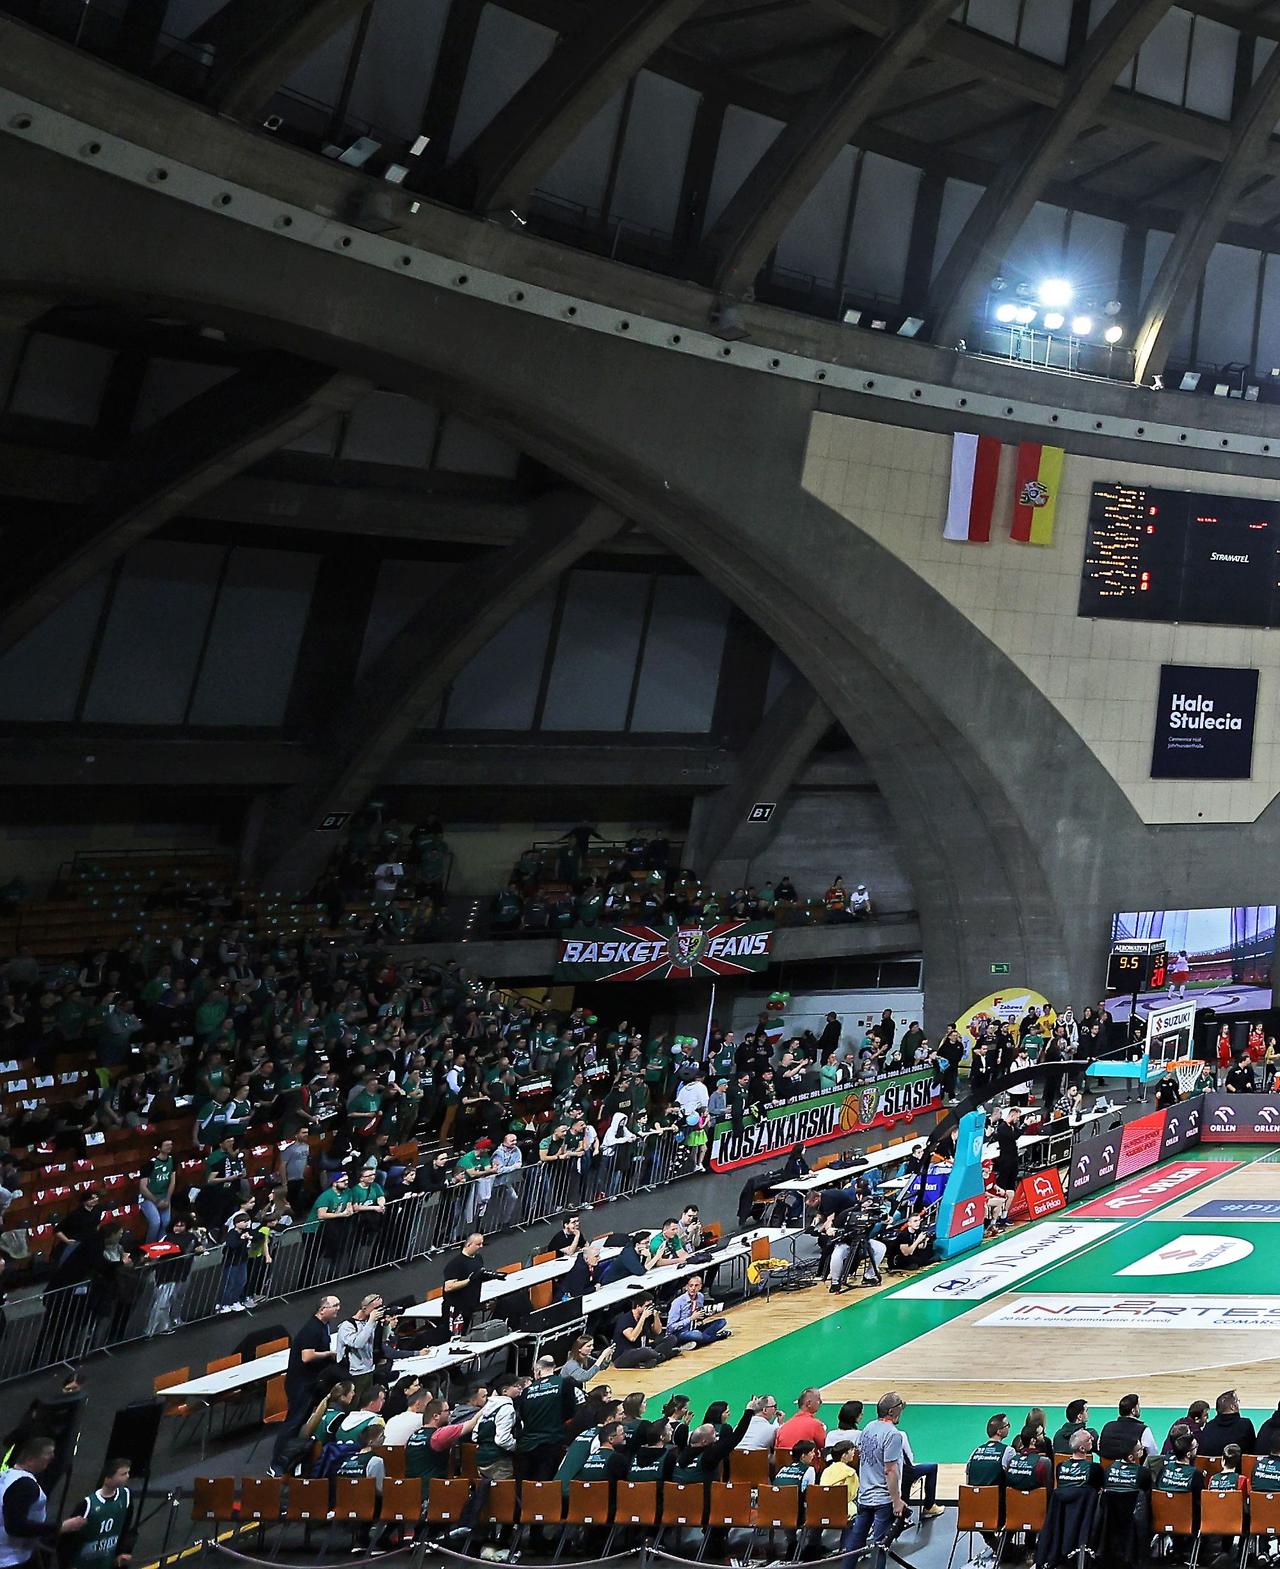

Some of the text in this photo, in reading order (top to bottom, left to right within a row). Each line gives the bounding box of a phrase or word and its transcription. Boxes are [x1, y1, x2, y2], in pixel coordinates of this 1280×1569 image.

[1210, 552, 1250, 564] STRAMATEL
[1171, 694, 1214, 712] Hala
[1169, 711, 1242, 730] Stulecia
[753, 807, 770, 818] B1
[562, 934, 770, 964] BASKET FANS
[1120, 956, 1139, 970] 9.5
[1164, 1012, 1190, 1028] SUZUKI
[1210, 1124, 1236, 1132] ORLEN
[1254, 1124, 1280, 1132] ORLEN
[1144, 1167, 1208, 1194] ORLEN
[1034, 1204, 1049, 1214] Bank
[980, 1224, 1084, 1268] Nawrot
[100, 1518, 114, 1533] 10
